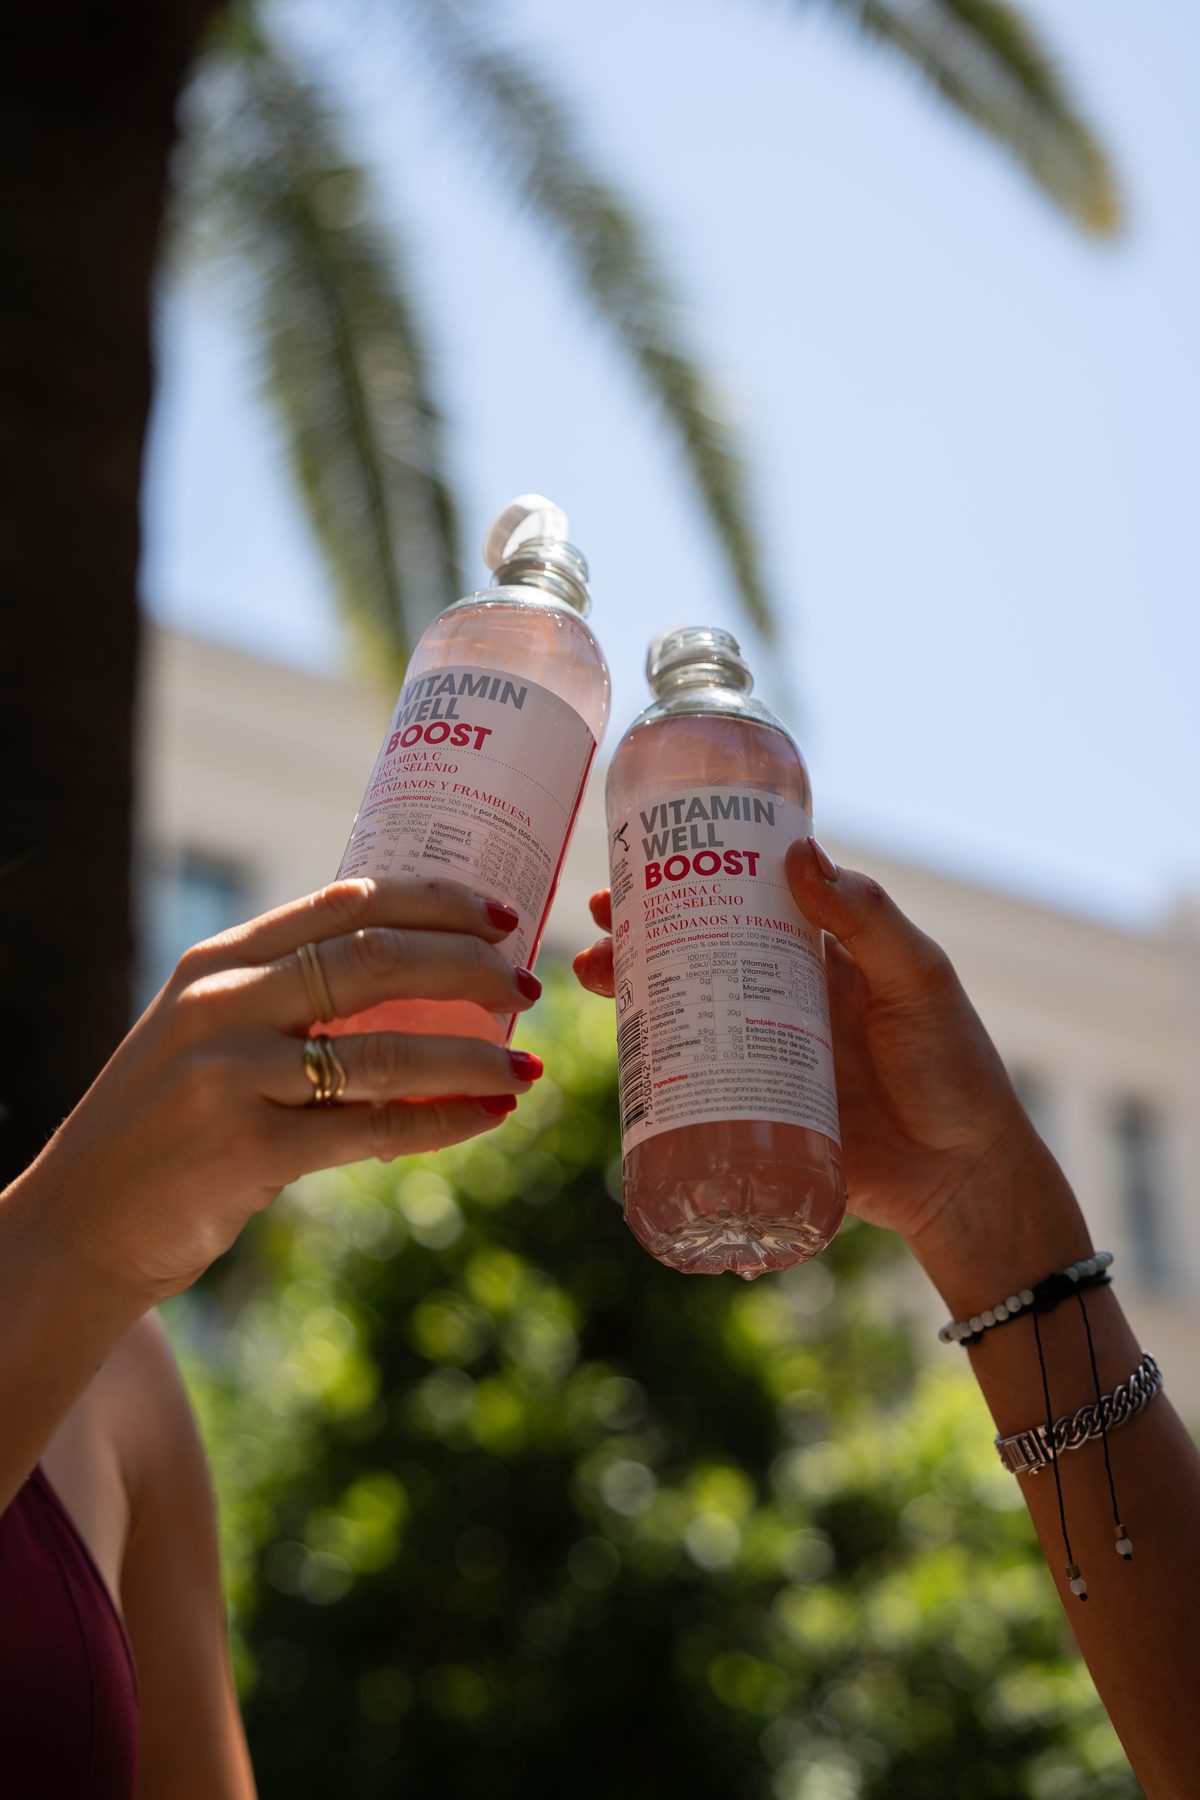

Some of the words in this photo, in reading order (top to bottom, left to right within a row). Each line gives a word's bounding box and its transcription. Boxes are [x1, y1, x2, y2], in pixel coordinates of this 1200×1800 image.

[403, 673, 528, 710] VITAMIN
[396, 698, 460, 729] WELL
[385, 721, 492, 755] BOOST
[378, 752, 427, 774] VITAMINA
[432, 752, 441, 761] C
[394, 795, 431, 803] nutricional
[448, 797, 460, 807] 100
[479, 808, 492, 817] por
[493, 815, 517, 831] botella
[441, 781, 449, 790] Y
[453, 783, 532, 827] FRAMBUESA
[431, 804, 457, 814] valores
[471, 813, 506, 833] referencia
[640, 796, 775, 833] VITAMIN
[430, 829, 463, 843] Vitamina
[433, 821, 464, 837] Vitamina
[642, 823, 724, 861] WELL
[422, 851, 451, 863] Selenio
[425, 844, 469, 862] Manganeso
[645, 850, 760, 890] BOOST
[642, 885, 707, 909] VITAMINA
[712, 884, 722, 894] C
[645, 895, 744, 922] ZINC+SELENIO
[645, 920, 657, 928] CON
[658, 914, 676, 925] SABOR
[645, 915, 728, 941] ARÁNDANOS
[732, 915, 741, 925] Y
[746, 916, 813, 945] FRAMBUESA
[615, 919, 630, 943] 500
[646, 937, 686, 954] Información
[687, 932, 729, 941] nutricional
[646, 949, 670, 963] porción
[677, 943, 698, 952] como
[732, 939, 758, 948] valores
[741, 960, 773, 968] Vitamina
[742, 968, 774, 977] Vitamina
[647, 972, 662, 981] Valor
[648, 975, 681, 989] energético
[648, 987, 670, 998] Grasas
[743, 985, 785, 995] Manganeso
[744, 993, 771, 1001] Selenio
[675, 1007, 685, 1015] de
[650, 1018, 676, 1031] carbono
[745, 1018, 777, 1027] También
[746, 1027, 776, 1035] Extracto
[639, 1011, 649, 1060] 719211
[747, 1035, 776, 1044] Extracto
[747, 1044, 777, 1052] Extracto
[748, 1052, 777, 1061] Extracto
[642, 1064, 653, 1111] 350042
